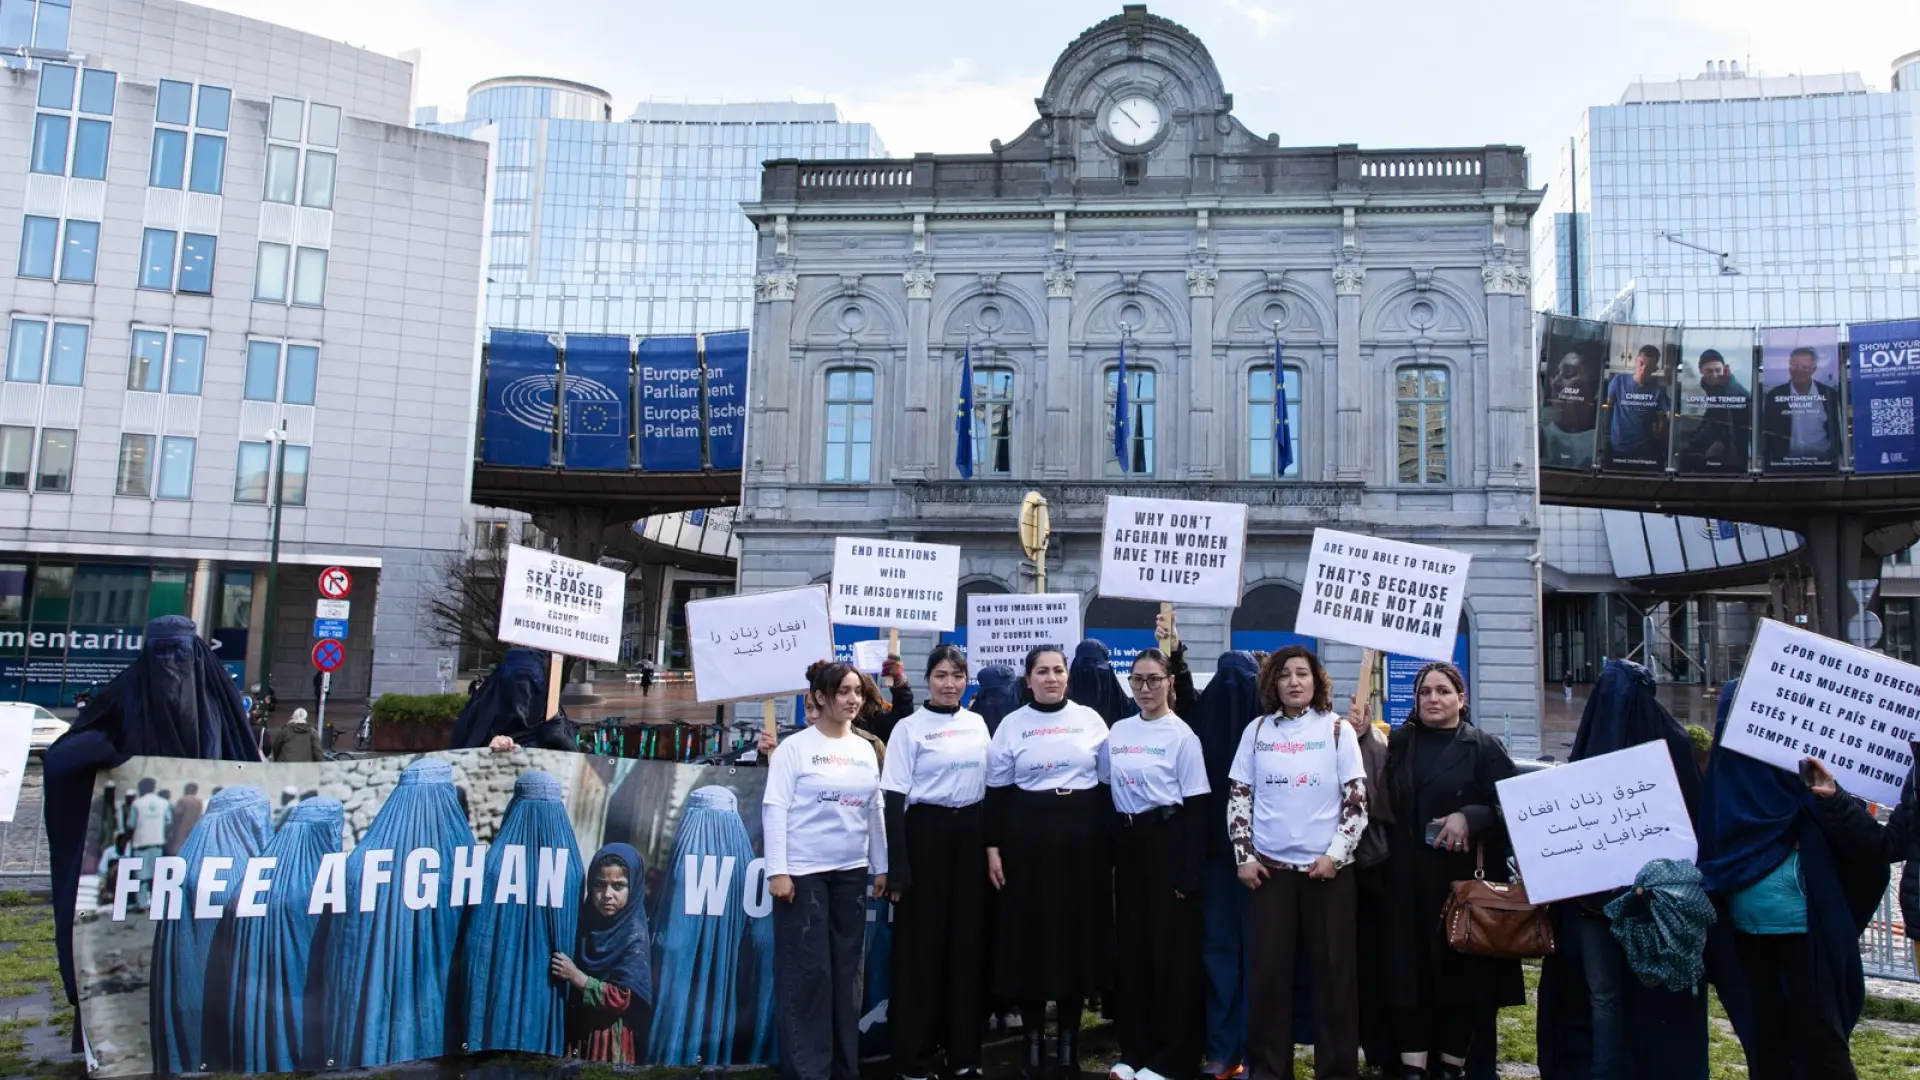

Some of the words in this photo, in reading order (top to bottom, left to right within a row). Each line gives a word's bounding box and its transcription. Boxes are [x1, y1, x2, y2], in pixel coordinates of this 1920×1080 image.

[1858, 342, 1890, 352] SHOW
[1892, 340, 1920, 348] YOUR
[1860, 348, 1920, 368] LOVE
[643, 367, 723, 382] European
[1626, 393, 1654, 401] CHRISTY
[1774, 394, 1827, 402] SENTIMENTAL
[644, 402, 745, 422] Europäische
[644, 423, 733, 438] Parlament
[1135, 512, 1164, 527] WHY
[1171, 515, 1211, 529] DON'T
[1116, 529, 1168, 545] AFGHAN
[1175, 532, 1228, 550] WOMEN
[851, 545, 872, 556] END
[878, 547, 937, 561] RELATIONS
[1114, 547, 1147, 562] HAVE
[1154, 550, 1178, 565] THE
[1185, 553, 1226, 568] RIGHT
[1323, 542, 1344, 555] ARE
[1349, 546, 1368, 560] YOU
[1372, 551, 1399, 565] ABLE
[1404, 556, 1417, 568] TO
[1422, 560, 1456, 575] TALK?
[550, 560, 584, 579] STOP
[880, 567, 906, 579] with
[1139, 568, 1154, 581] TO
[1161, 570, 1200, 585] LIVE?
[526, 569, 603, 599] SEX-BASED
[1318, 564, 1371, 586] THAT'S
[1378, 575, 1448, 601] BECAUSE
[525, 585, 601, 614] APARTHEID
[840, 584, 858, 596] THE
[863, 586, 943, 601] MISOGYNISTIC
[1316, 581, 1344, 600] YOU
[1350, 588, 1380, 607] ARE
[1386, 595, 1416, 614] NOT
[1423, 603, 1444, 620] AN
[845, 605, 890, 618] TALIBAN
[896, 608, 938, 621] REGIME
[1046, 603, 1067, 611] WHAT
[995, 618, 1015, 626] DAILY
[1313, 599, 1374, 624] AFGHAN
[1381, 612, 1442, 638] WOMAN
[514, 617, 572, 637] MISOGYNISTIC
[576, 630, 610, 644] POLICIES
[730, 627, 759, 640] زنان
[768, 620, 806, 636] افغان
[1004, 631, 1032, 639] COURSE
[710, 631, 721, 644] را
[772, 635, 797, 651] آزاد
[734, 641, 763, 656] کنید
[980, 645, 1004, 653] WHICH
[1783, 644, 1815, 661] ¿POR
[1846, 663, 1870, 679] LOS
[1771, 661, 1786, 675] DE
[1790, 668, 1812, 683] LAS
[1817, 677, 1874, 704] MUJERES
[1776, 687, 1815, 708] SEGÚN
[1818, 701, 1831, 714] EL
[1837, 707, 1866, 726] PAÍS
[1870, 719, 1887, 733] EN
[1891, 726, 1916, 742] QUE
[1750, 701, 1785, 721] ESTÉS
[1791, 714, 1798, 726] Y
[1802, 719, 1814, 732] EL
[1820, 725, 1836, 739] DE
[1839, 733, 1863, 748] LOS
[1746, 723, 1799, 750] SIEMPRE
[1803, 743, 1827, 760] SON
[1831, 754, 1854, 770] LOS
[1858, 764, 1904, 788] MISMO
[1613, 780, 1657, 800] حقوق
[1570, 791, 1603, 810] زنان
[1518, 800, 1560, 821] افغان
[1611, 802, 1648, 824] ابزار
[1548, 816, 1599, 834] سیاست
[1541, 840, 1584, 858] نیست
[112, 856, 277, 922] FREE
[308, 844, 569, 915] AFGHAN
